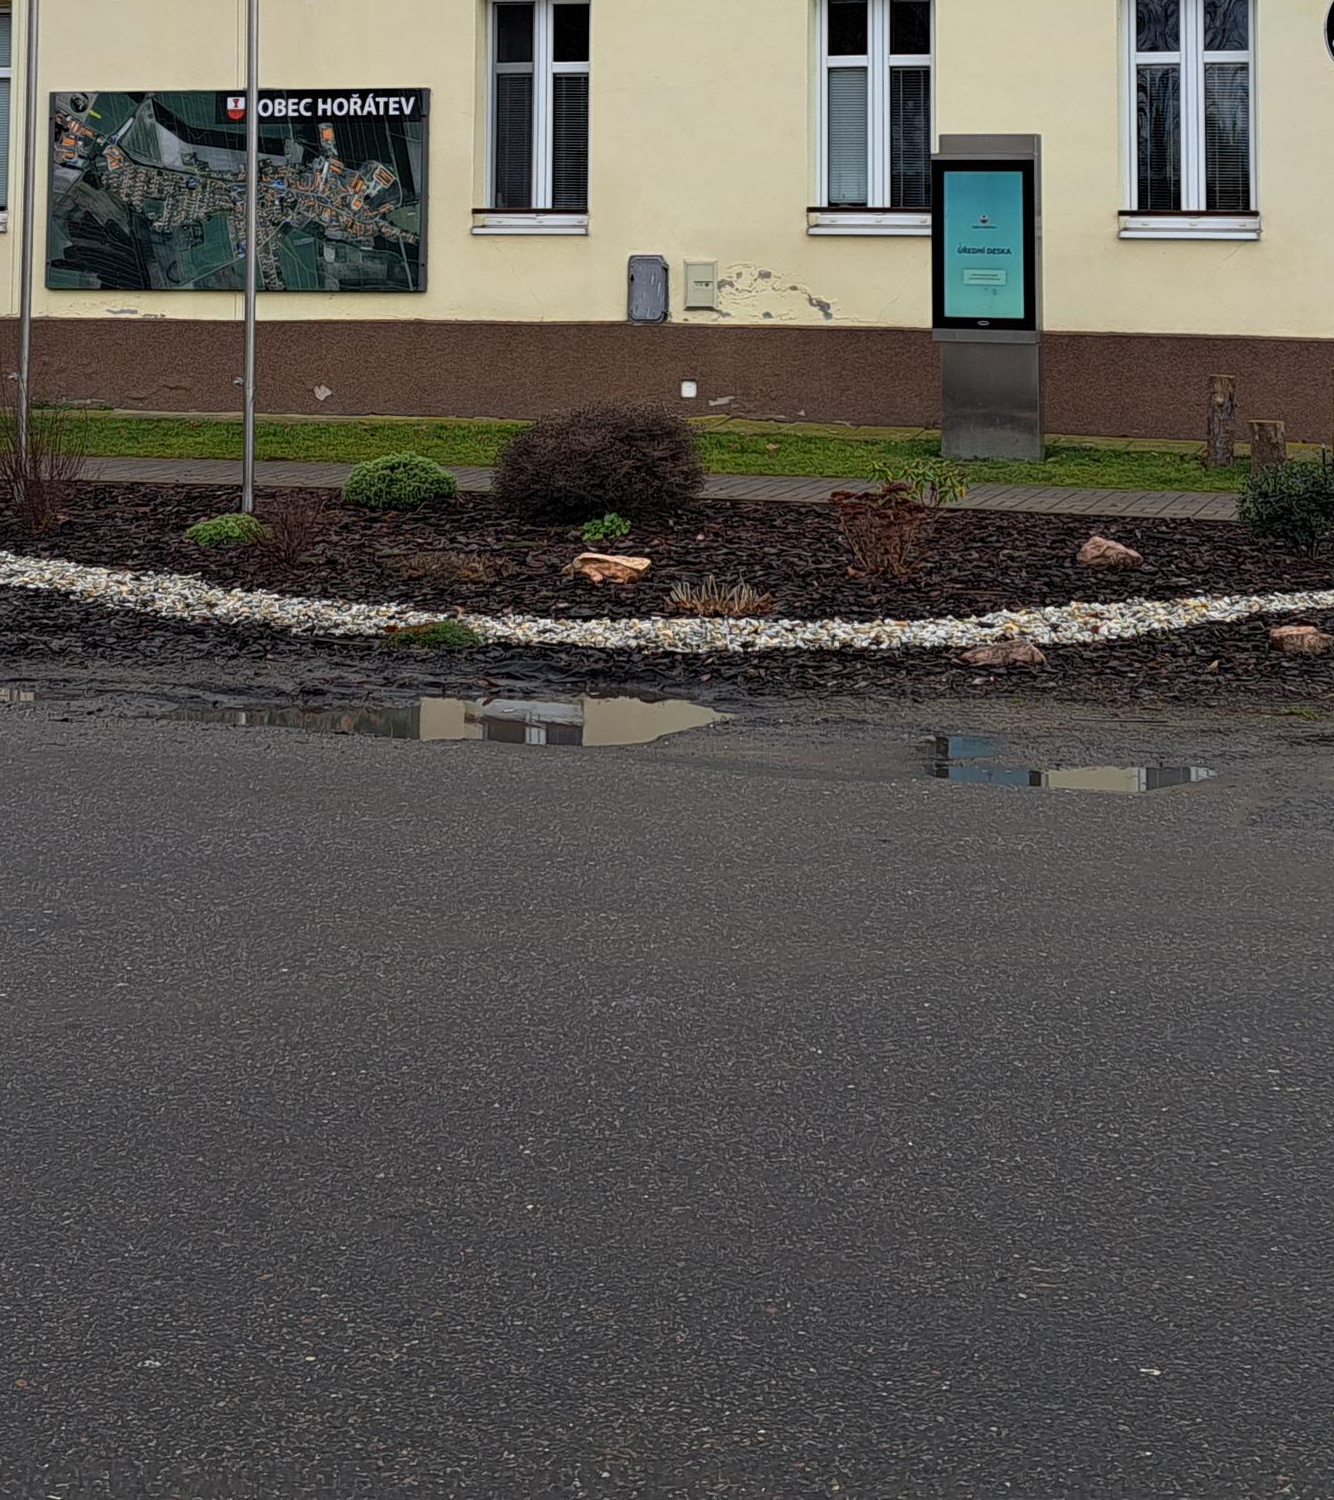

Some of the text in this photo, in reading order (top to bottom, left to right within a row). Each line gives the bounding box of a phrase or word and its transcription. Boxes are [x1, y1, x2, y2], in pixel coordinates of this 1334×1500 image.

[257, 93, 416, 117] OBEC HOŘÁTEV
[987, 247, 1012, 255] DESKA
